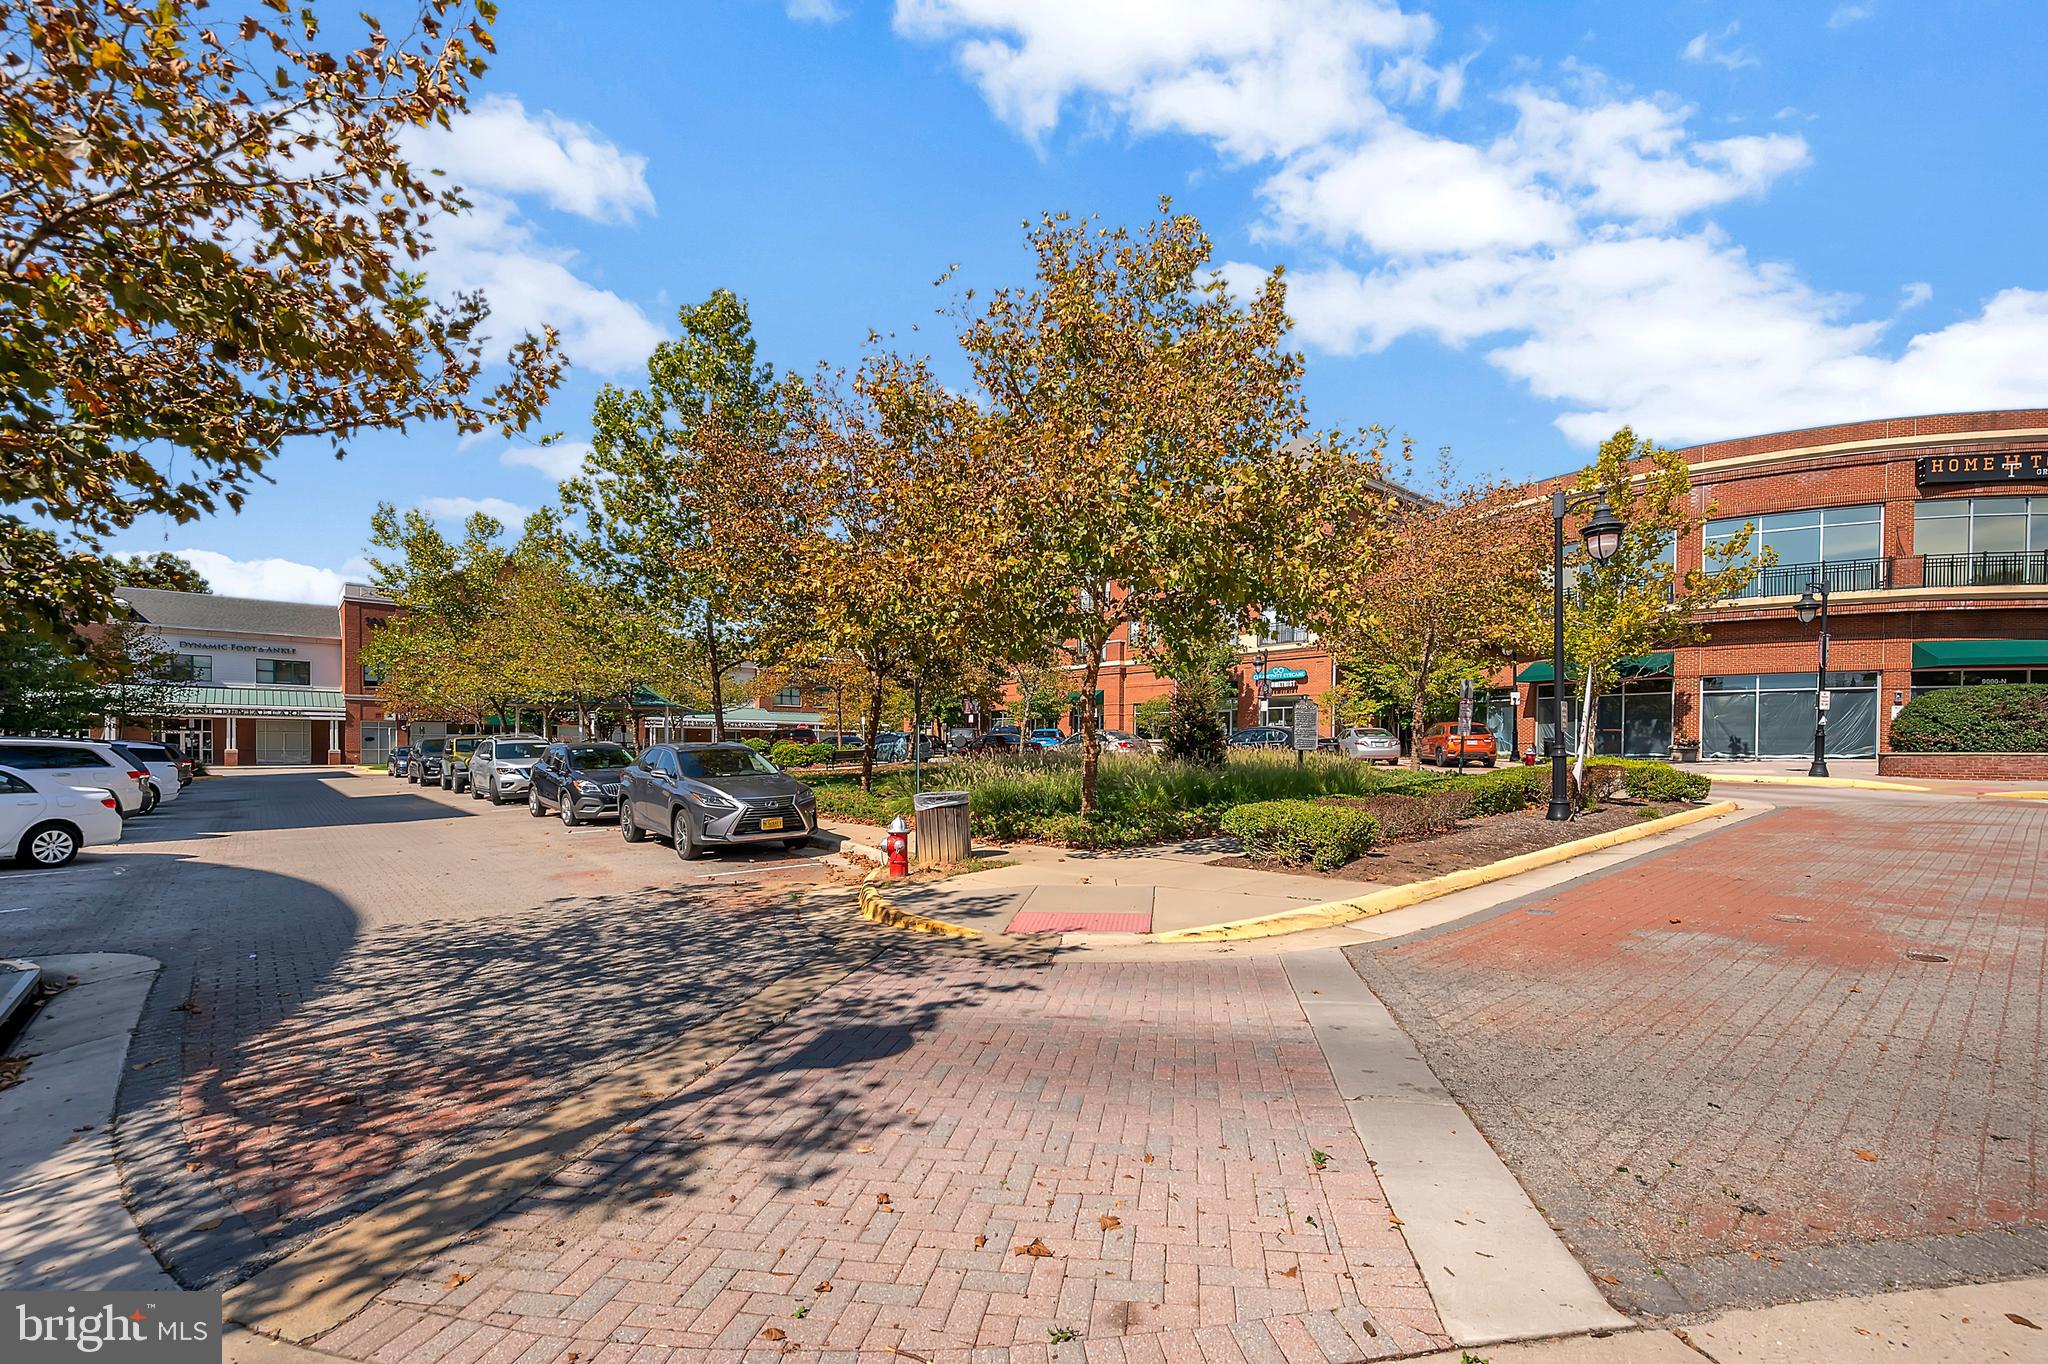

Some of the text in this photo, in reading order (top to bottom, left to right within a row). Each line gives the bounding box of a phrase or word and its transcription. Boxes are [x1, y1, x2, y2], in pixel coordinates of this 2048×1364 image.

[1931, 457, 1994, 473] HOME
[2030, 455, 2048, 469] T
[179, 640, 229, 651] DYNAMIC
[231, 643, 256, 653] FOOT
[266, 645, 297, 655] ANKLE
